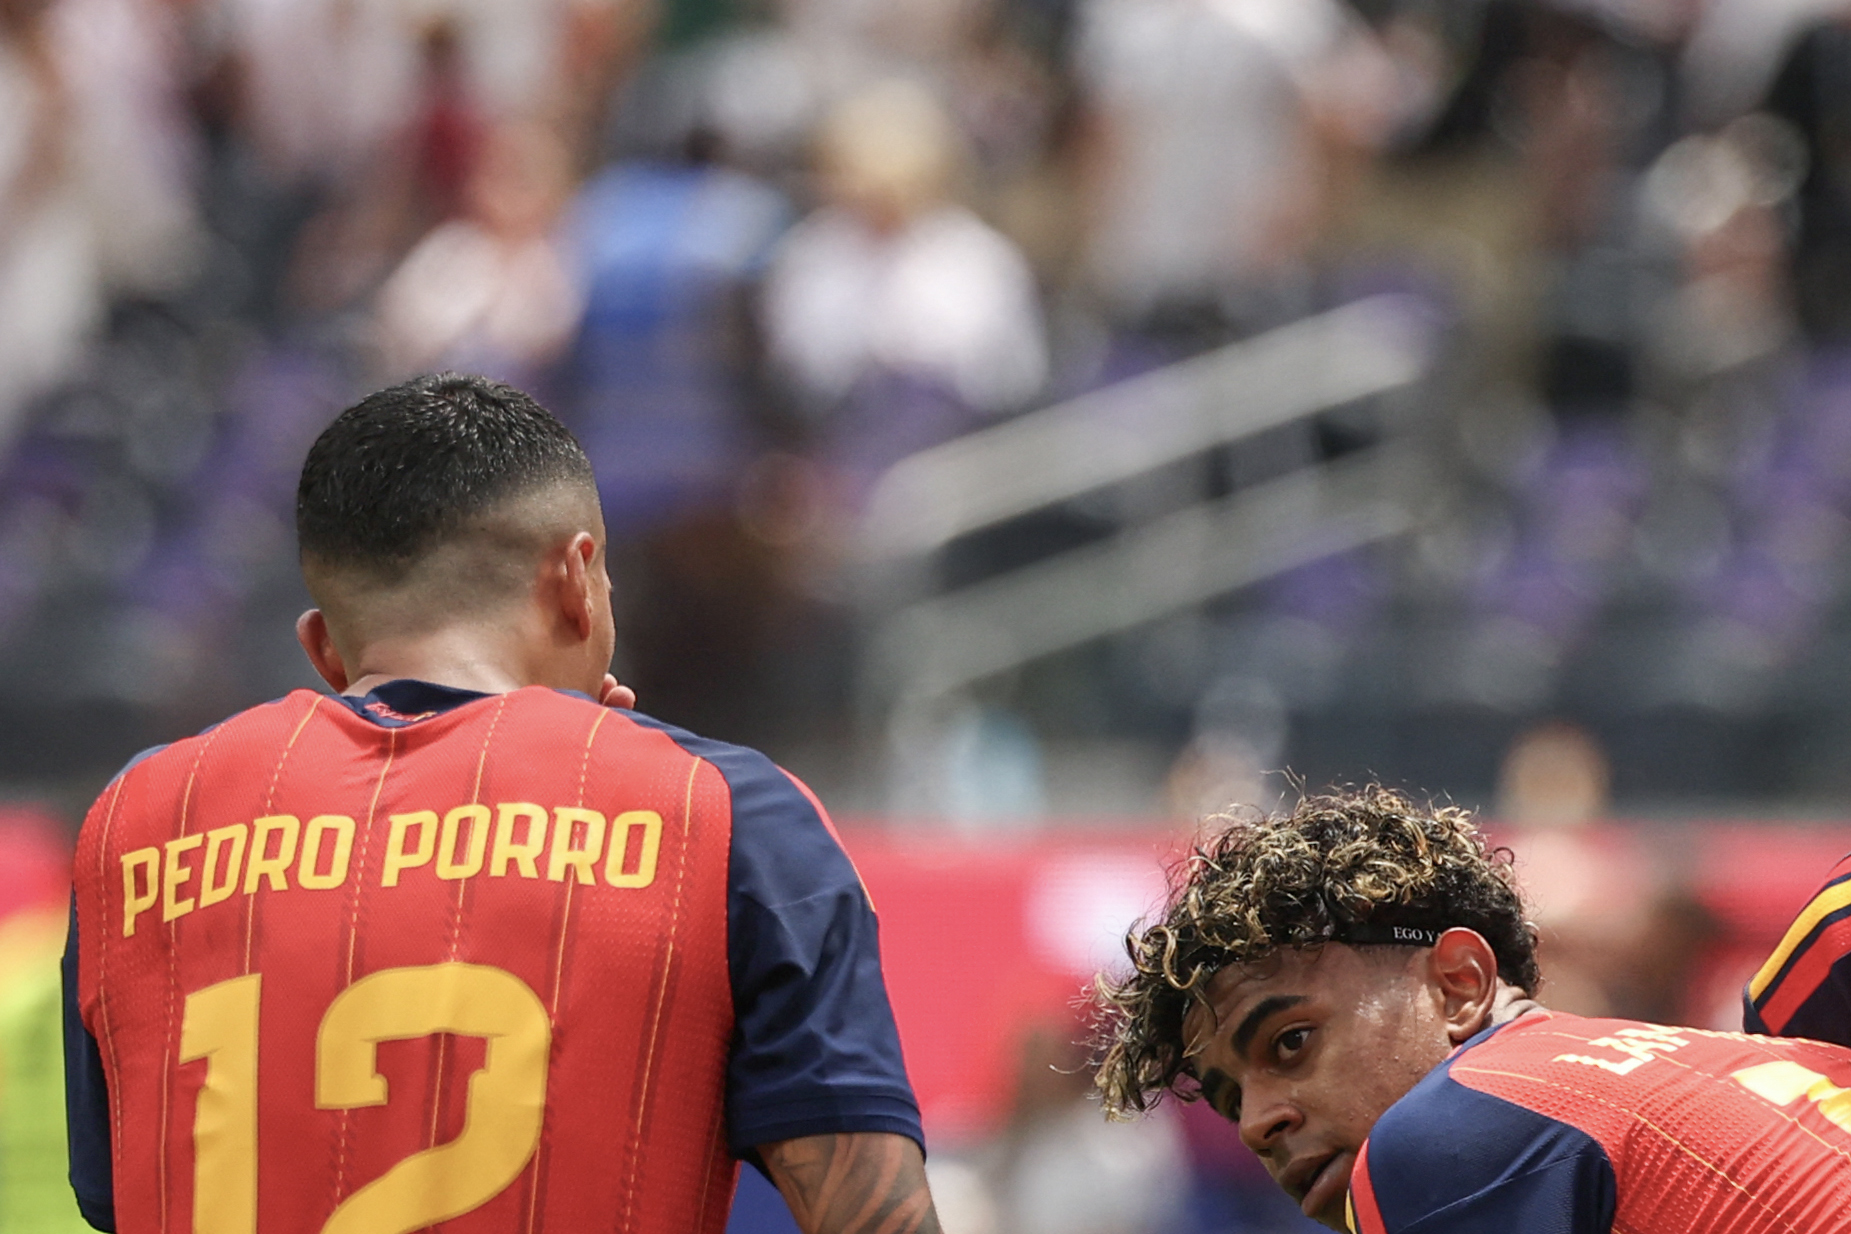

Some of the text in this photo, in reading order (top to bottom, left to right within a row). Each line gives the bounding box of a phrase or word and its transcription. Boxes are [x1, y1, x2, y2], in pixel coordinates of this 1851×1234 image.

[120, 801, 664, 938] PEDRO PORRO
[1393, 926, 1442, 943] EGO Y
